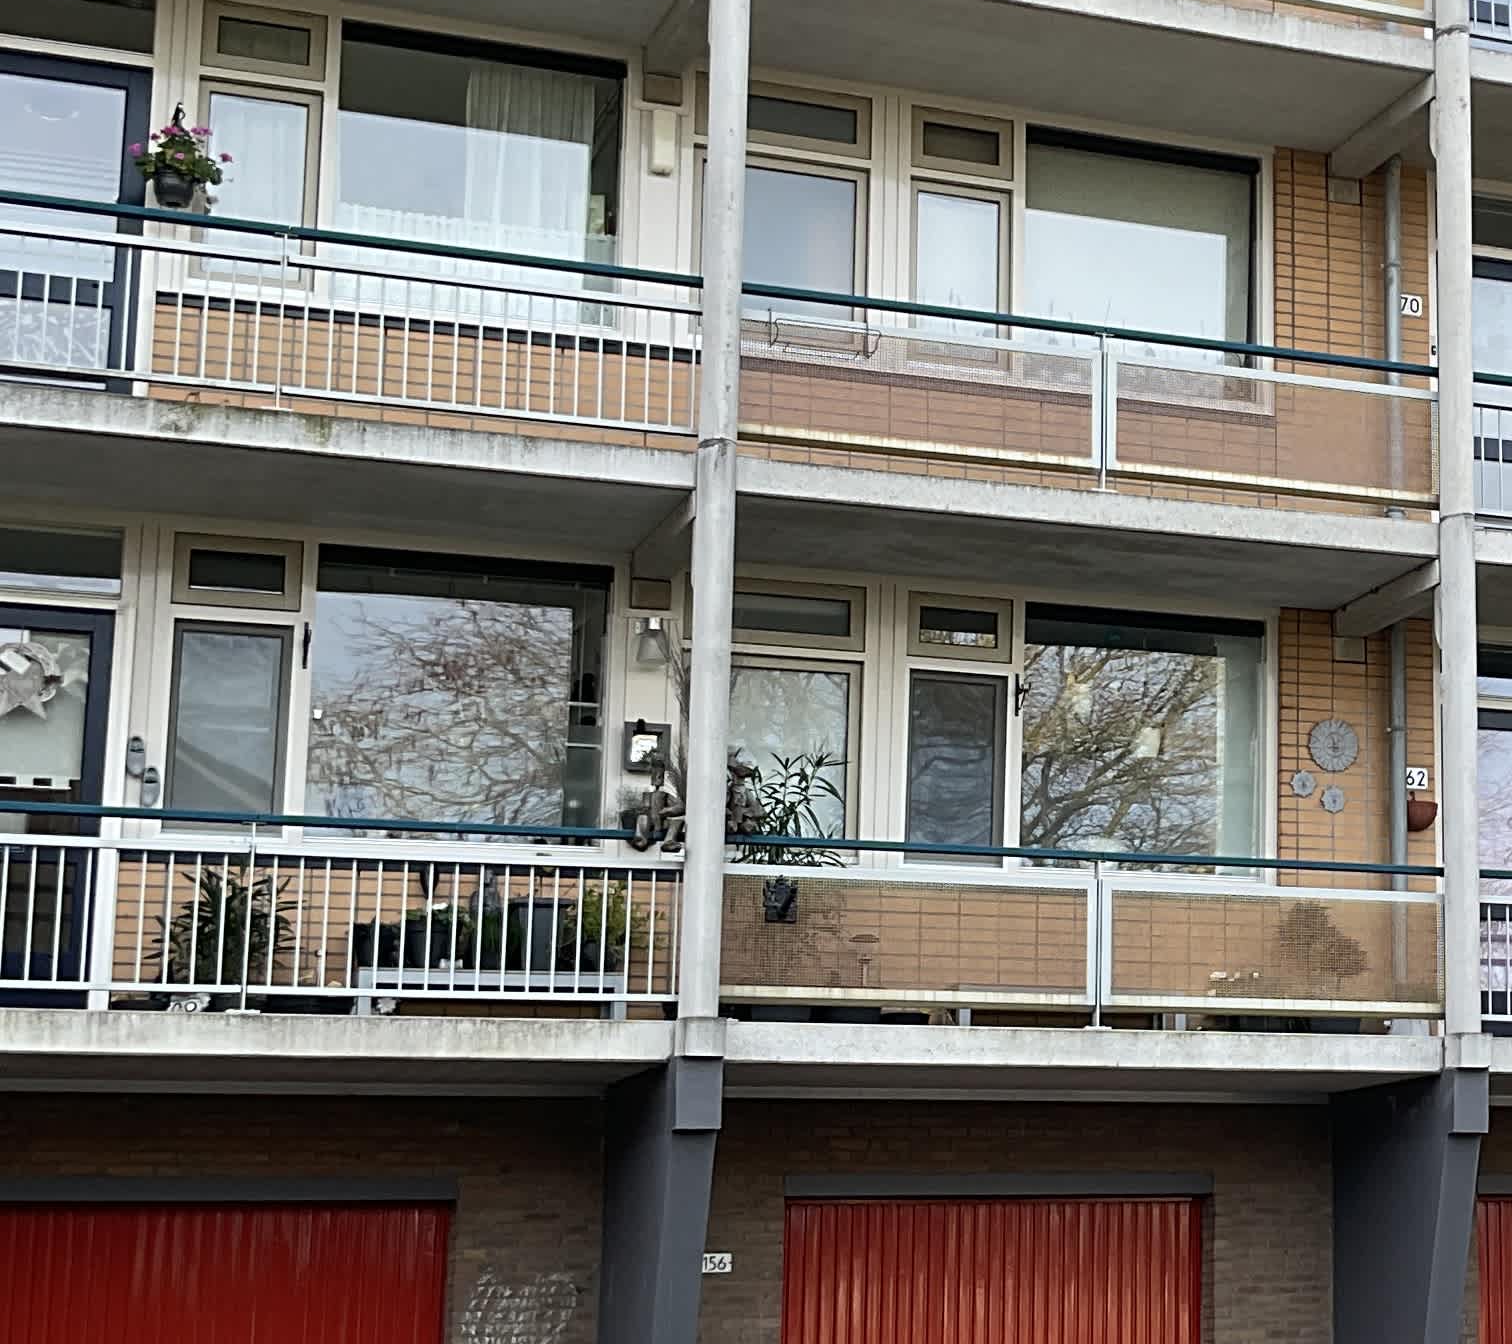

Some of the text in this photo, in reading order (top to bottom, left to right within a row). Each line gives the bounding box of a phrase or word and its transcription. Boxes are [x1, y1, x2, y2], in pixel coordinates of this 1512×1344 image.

[1400, 296, 1420, 313] 70
[1405, 769, 1426, 787] 62
[703, 1255, 727, 1271] 156
